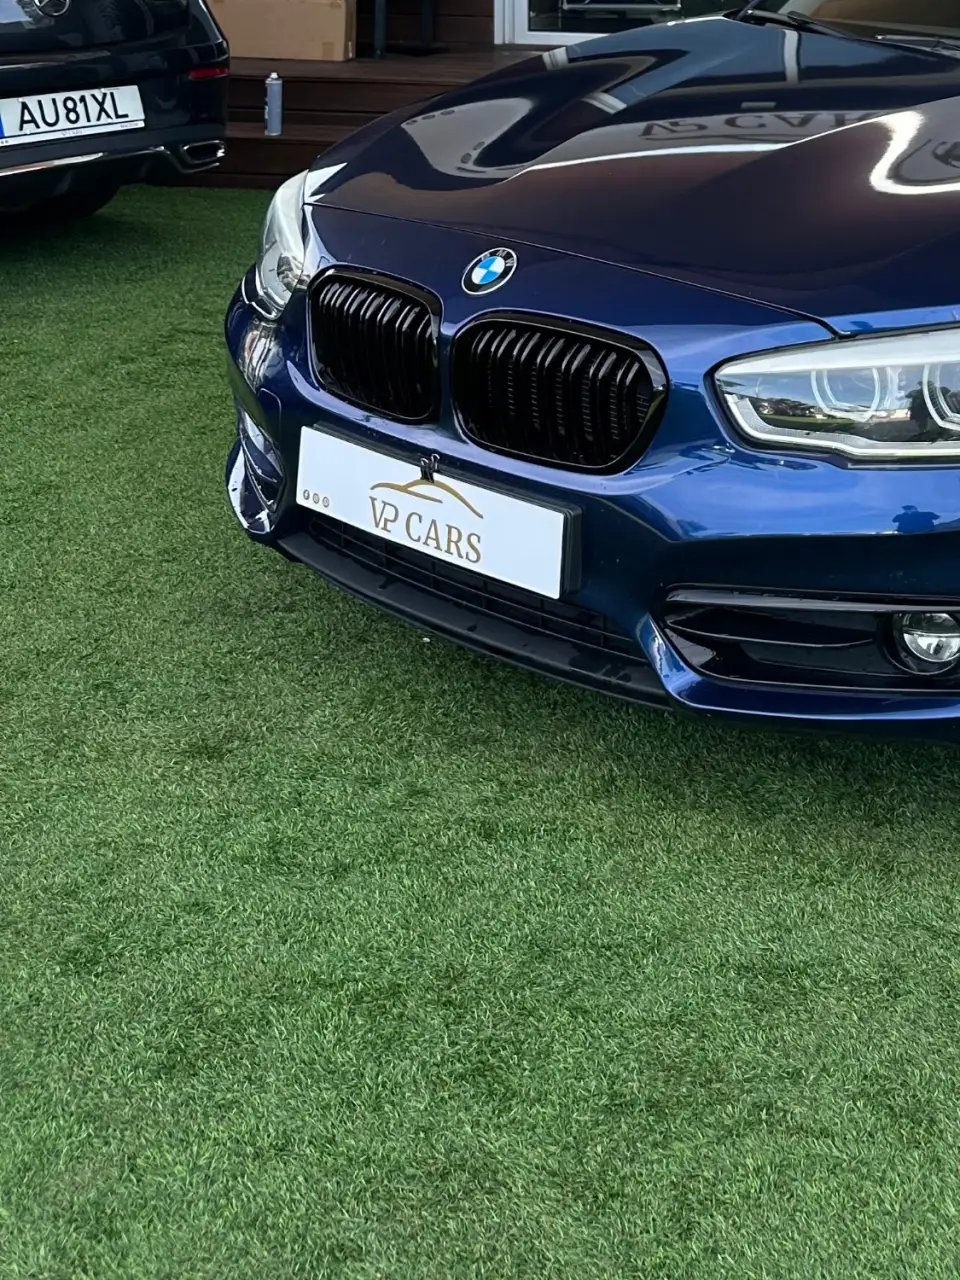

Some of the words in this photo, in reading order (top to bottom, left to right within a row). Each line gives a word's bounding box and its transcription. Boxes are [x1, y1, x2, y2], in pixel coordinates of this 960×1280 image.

[18, 91, 129, 131] AU81XL
[369, 495, 400, 533] VP
[405, 511, 482, 564] CARS
